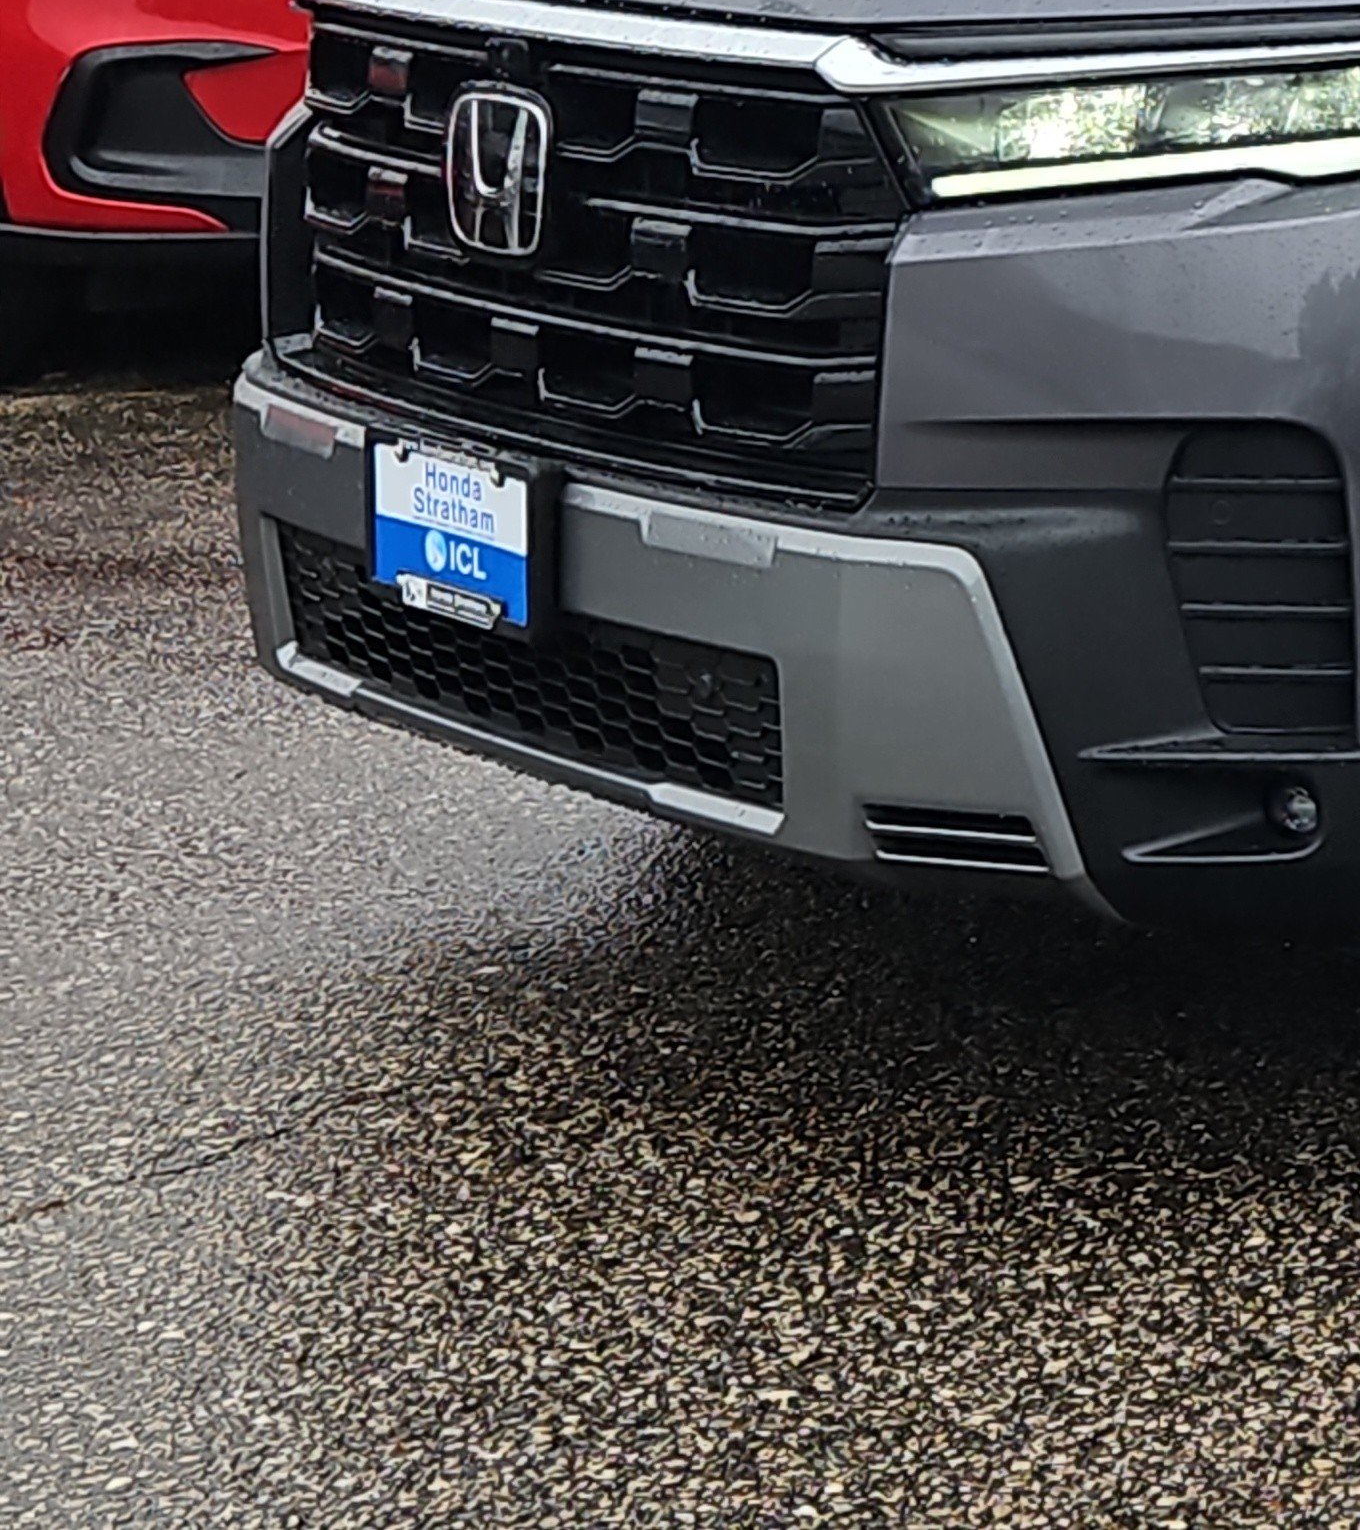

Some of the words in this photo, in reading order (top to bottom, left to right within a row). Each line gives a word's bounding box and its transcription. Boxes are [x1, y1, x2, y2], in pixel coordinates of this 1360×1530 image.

[425, 463, 482, 501] Honda
[413, 487, 495, 533] Stratham
[450, 541, 487, 580] ICL
